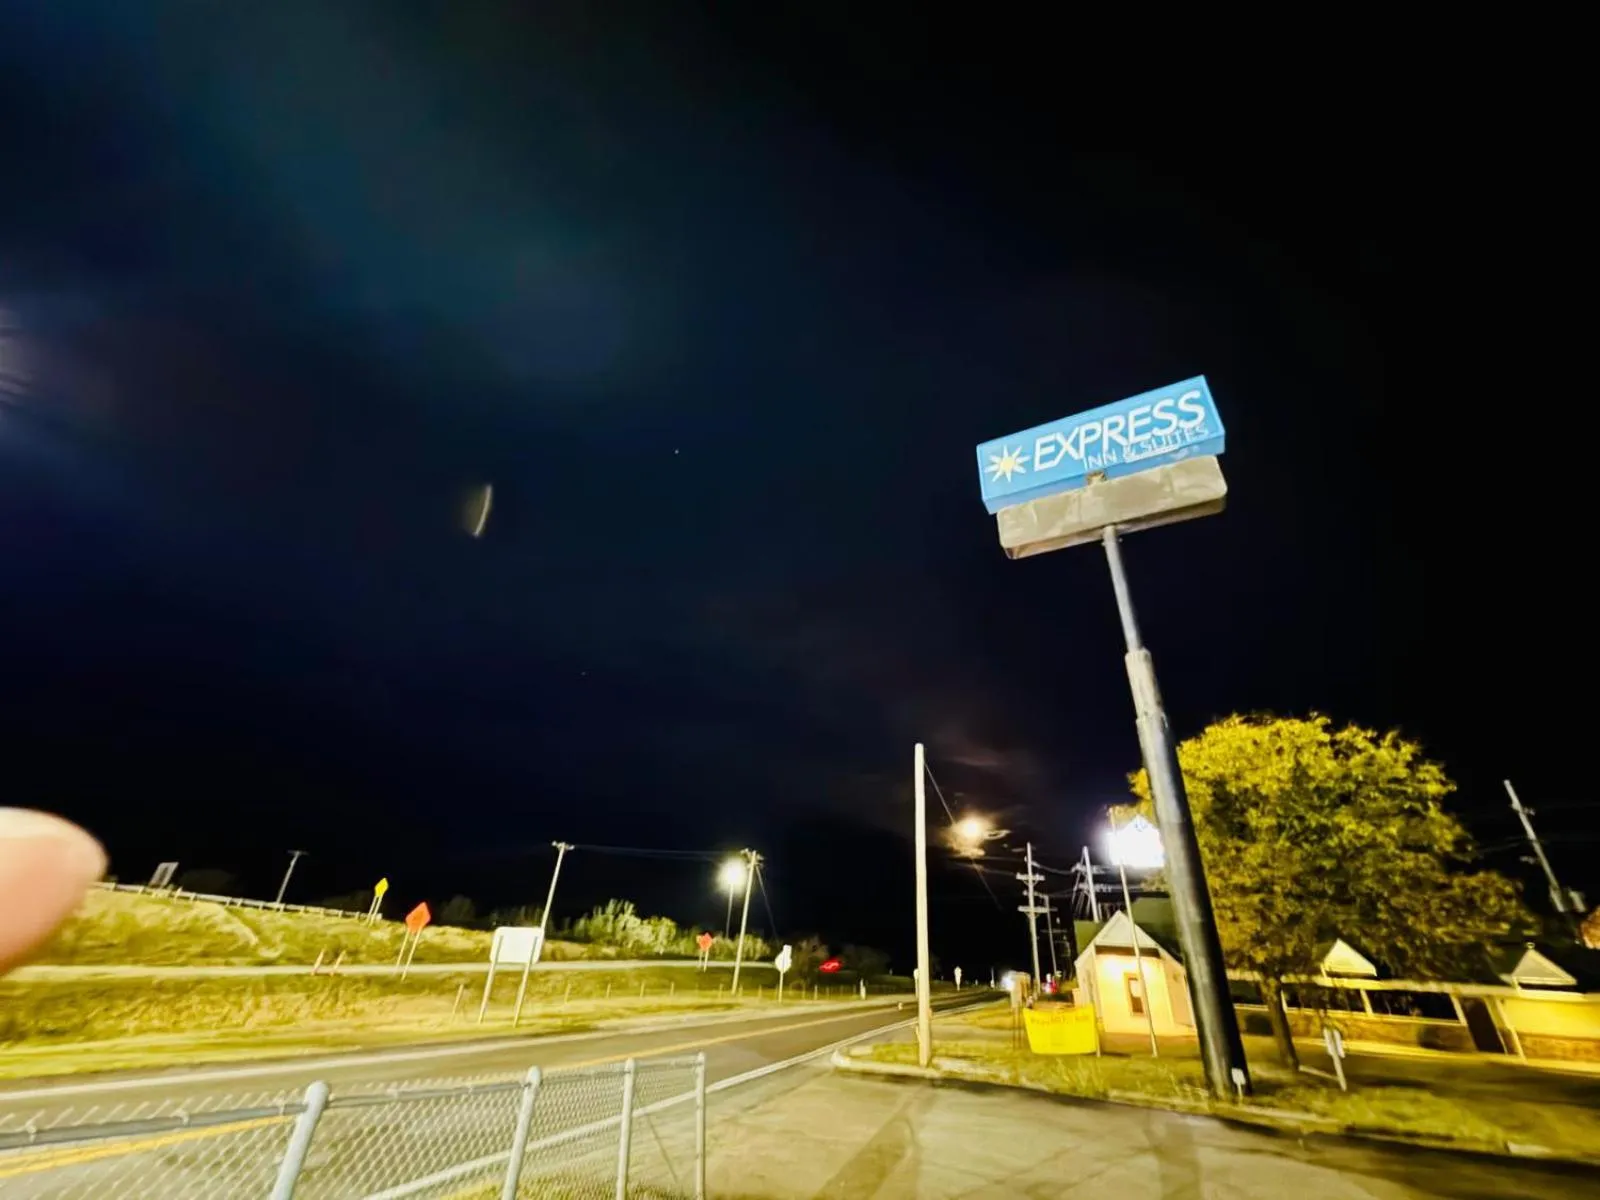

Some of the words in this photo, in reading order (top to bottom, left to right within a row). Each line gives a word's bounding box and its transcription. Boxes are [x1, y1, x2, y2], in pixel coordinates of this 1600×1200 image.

[1034, 390, 1206, 472] EXPRESS
[1083, 449, 1116, 471] INN
[1123, 443, 1138, 459] &
[1140, 425, 1207, 453] SUITES
